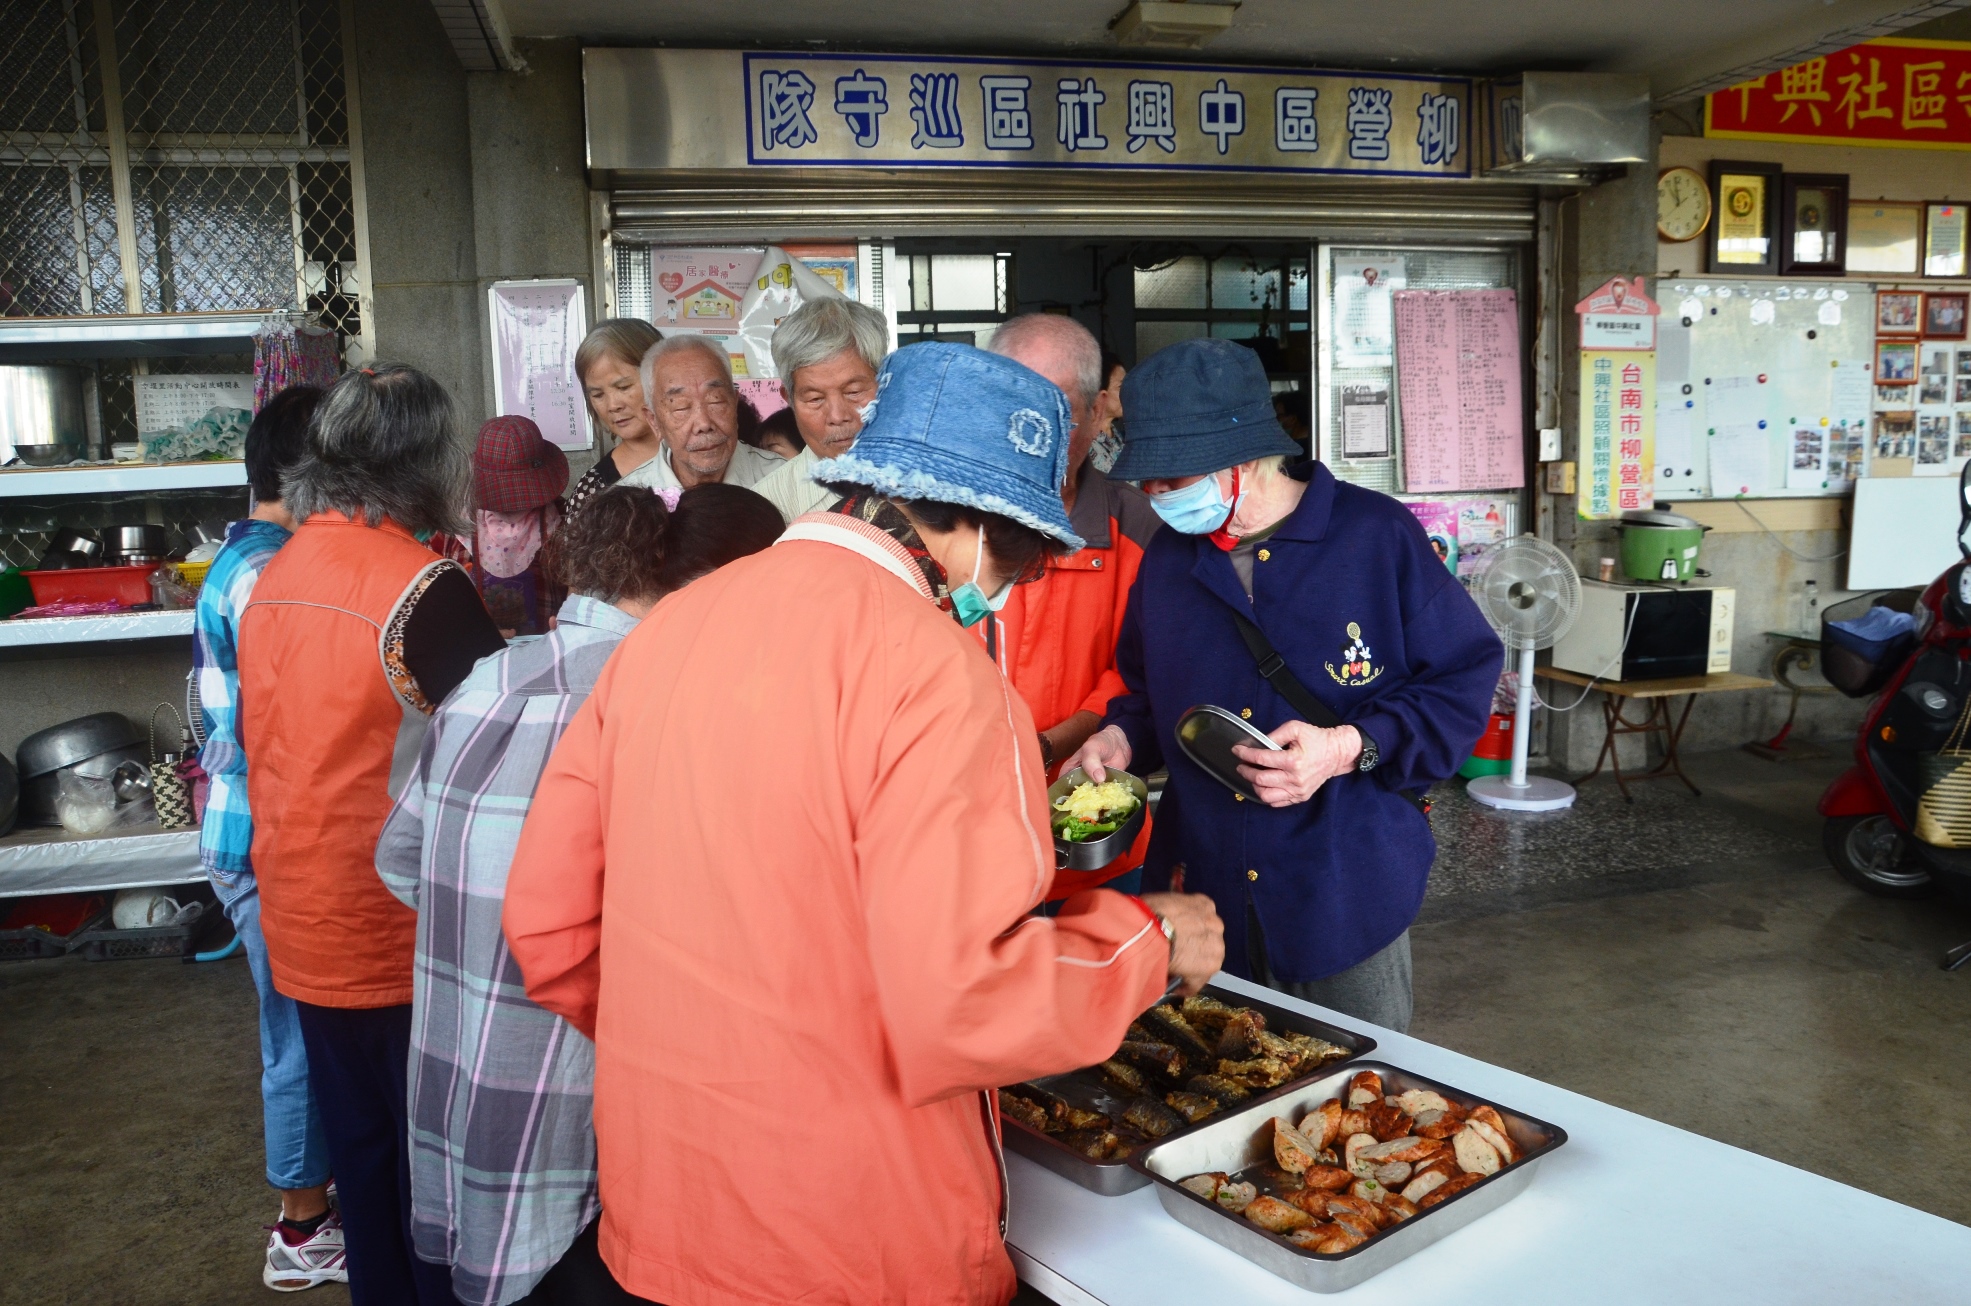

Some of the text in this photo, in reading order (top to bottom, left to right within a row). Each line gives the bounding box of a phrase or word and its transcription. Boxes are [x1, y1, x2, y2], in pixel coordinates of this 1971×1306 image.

[1728, 53, 1971, 131] 中興社區
[686, 265, 728, 279] 居家醫療
[1619, 362, 1642, 509] 台南市柳營區
[1350, 665, 1384, 686] Casual
